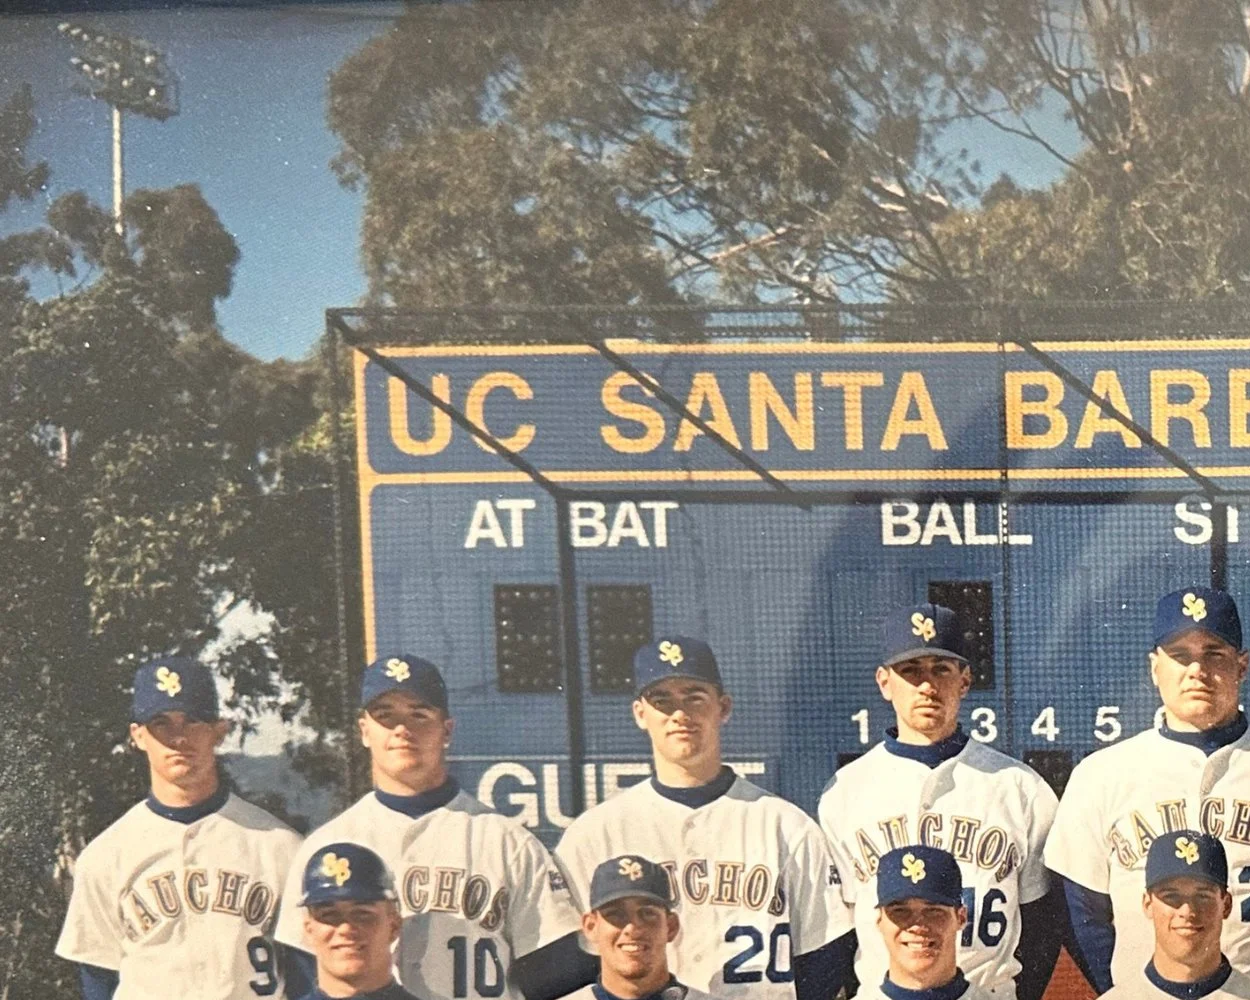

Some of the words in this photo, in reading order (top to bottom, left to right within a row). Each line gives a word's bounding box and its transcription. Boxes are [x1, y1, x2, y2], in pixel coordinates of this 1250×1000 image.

[387, 370, 537, 455] UC
[601, 367, 949, 454] SANTA
[464, 500, 537, 549] AT
[571, 500, 680, 549] BAT
[881, 501, 1034, 547] BALL
[851, 710, 870, 744] 1
[971, 708, 998, 743] 3
[1031, 706, 1060, 741] 4
[1094, 706, 1122, 741] 5
[477, 762, 766, 828] GUE
[119, 867, 277, 942] AUCHO
[961, 887, 1008, 947] 16
[247, 936, 278, 996] 9
[448, 935, 506, 999] 10
[724, 925, 793, 984] 20
